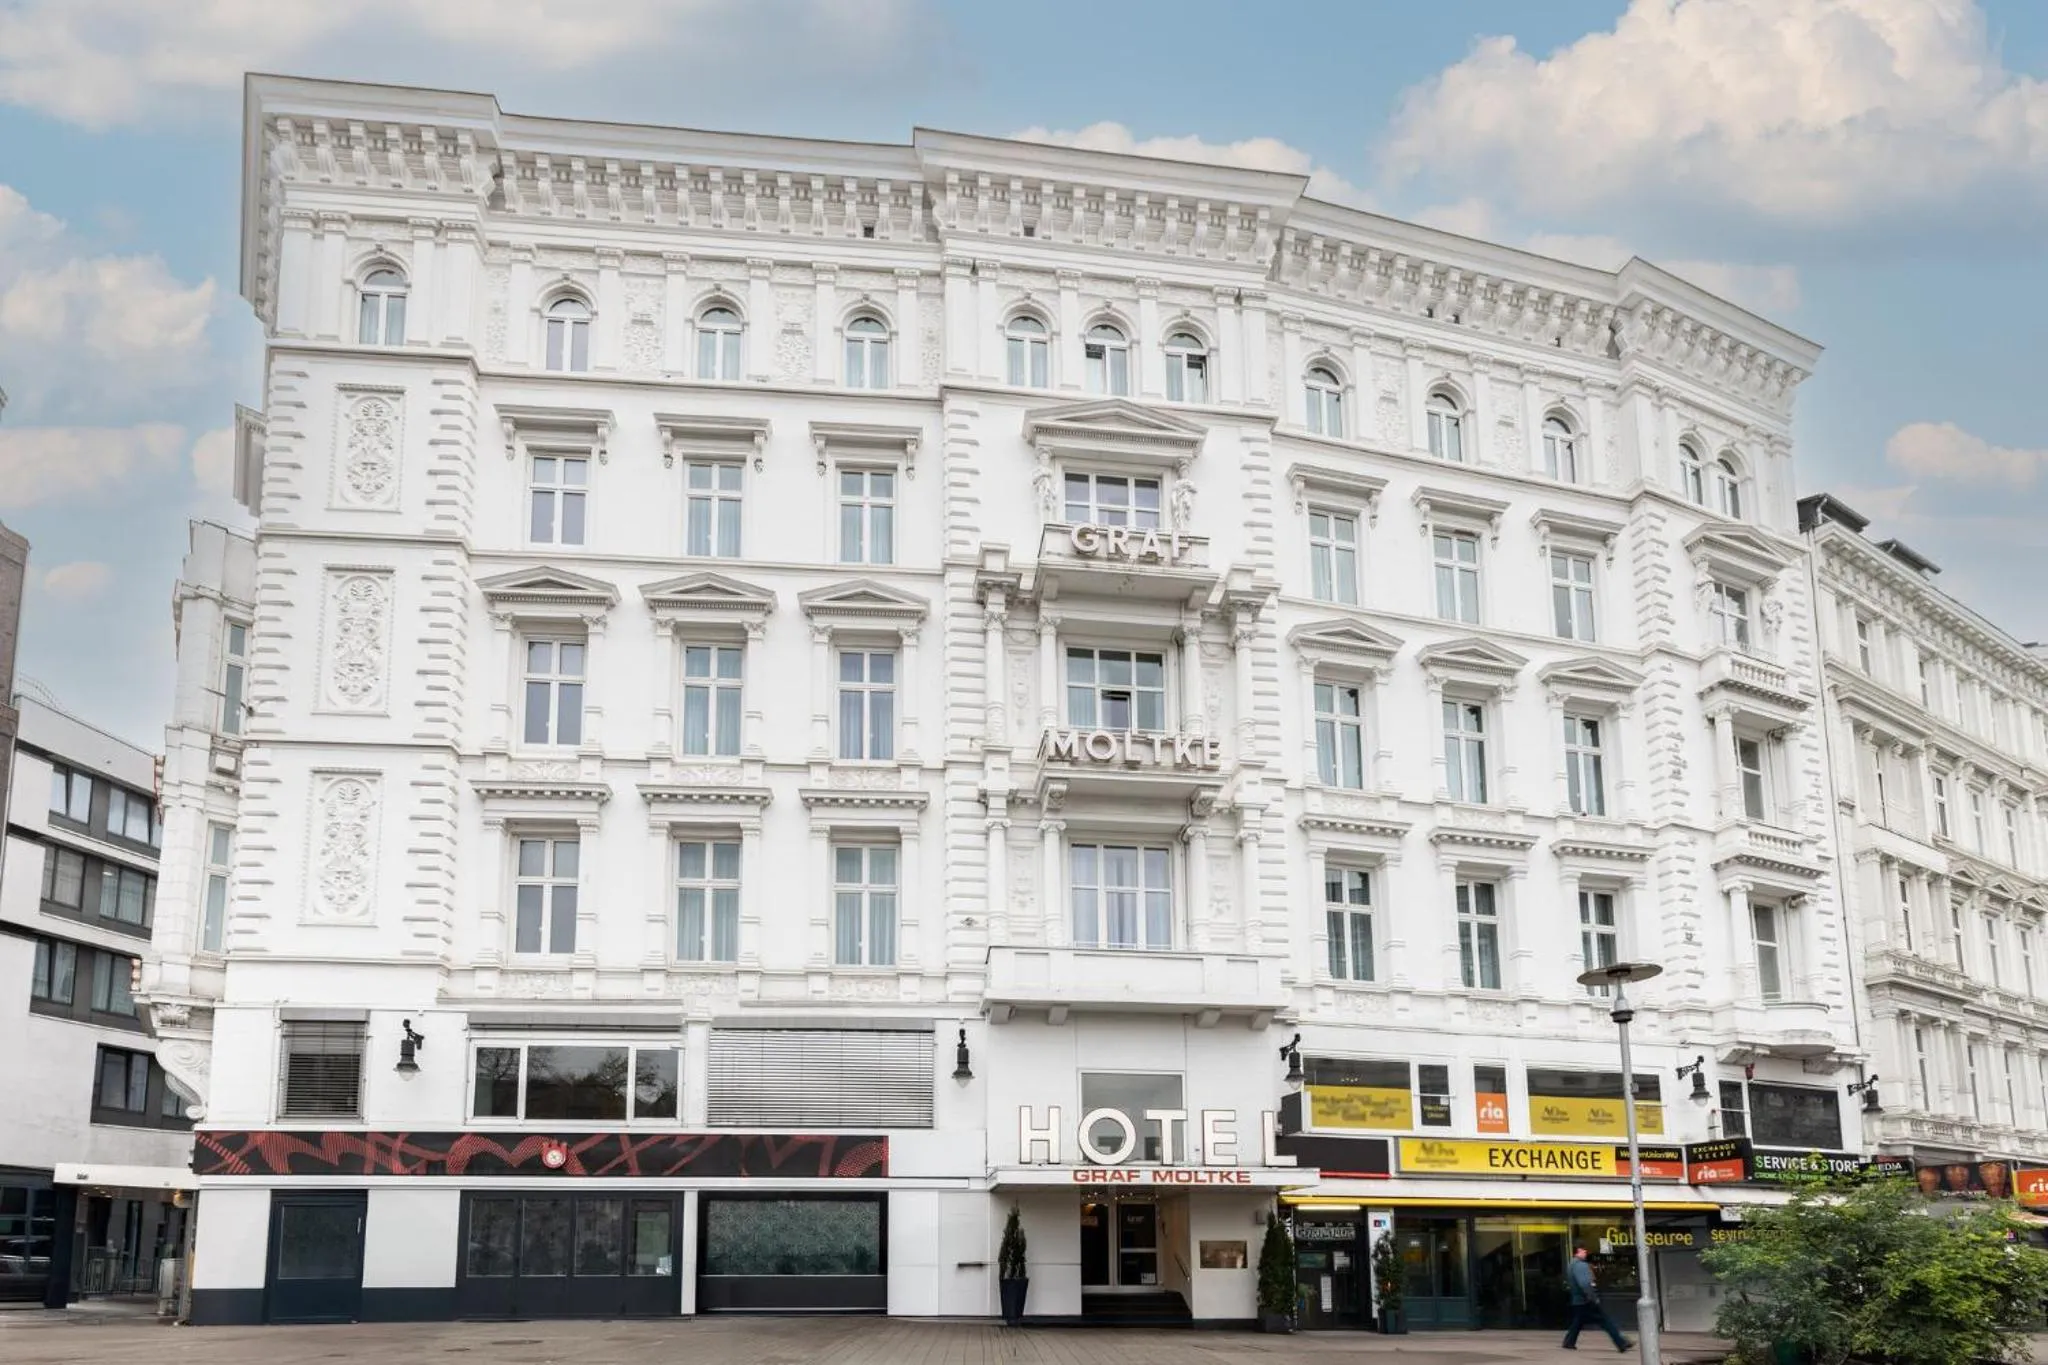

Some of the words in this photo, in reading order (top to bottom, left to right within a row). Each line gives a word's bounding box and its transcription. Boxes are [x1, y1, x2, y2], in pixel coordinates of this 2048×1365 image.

[1071, 523, 1192, 559] GRAF
[1048, 730, 1221, 768] MOLTKE
[1480, 1101, 1504, 1119] ria
[1018, 1105, 1299, 1167] HOTEL
[1693, 1143, 1736, 1154] EXCHANGE
[1488, 1148, 1603, 1170] EXCHANGE
[1755, 1156, 1809, 1171] SERVICE
[1821, 1159, 1859, 1173] STORE
[1072, 1169, 1141, 1183] GRAF
[1152, 1170, 1252, 1184] MOLTKE
[1697, 1165, 1717, 1180] ria
